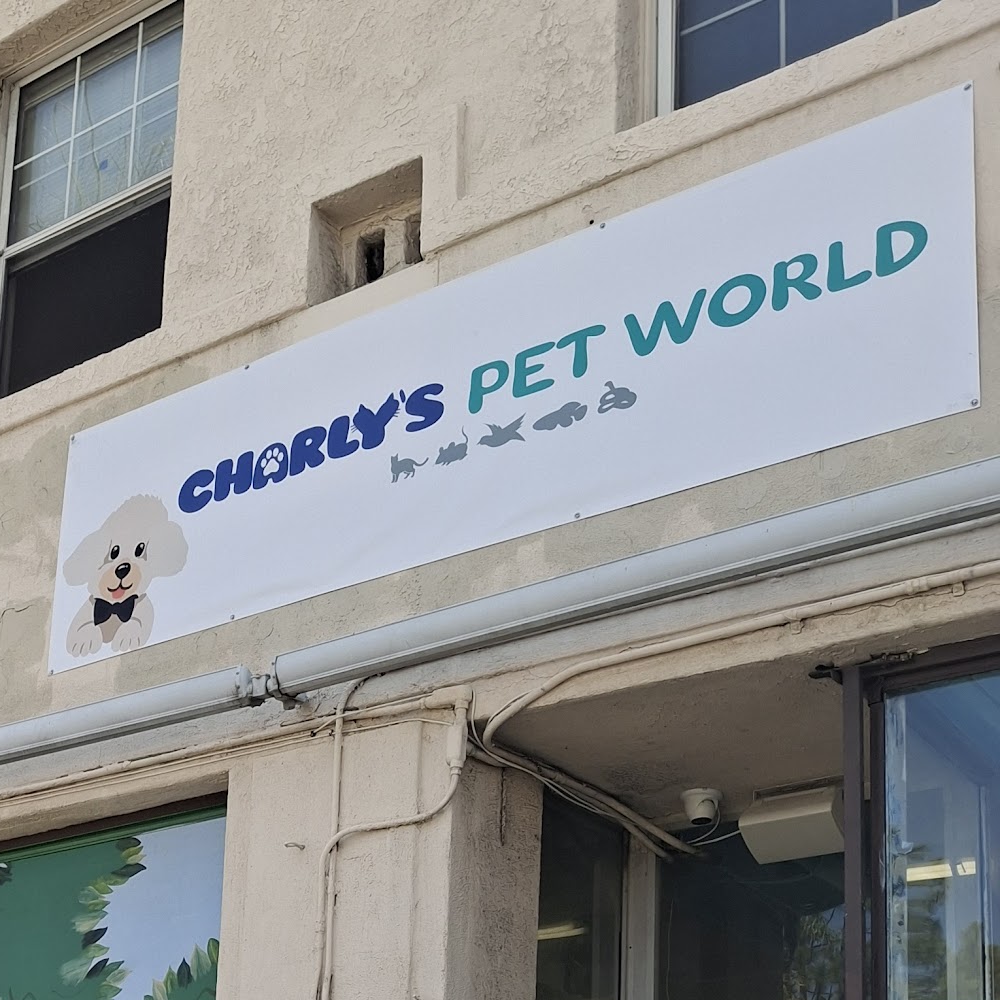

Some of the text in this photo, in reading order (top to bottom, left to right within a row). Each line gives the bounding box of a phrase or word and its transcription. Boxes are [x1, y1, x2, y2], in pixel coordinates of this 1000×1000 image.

[178, 220, 928, 513] CHARLY'S PET WORLD
